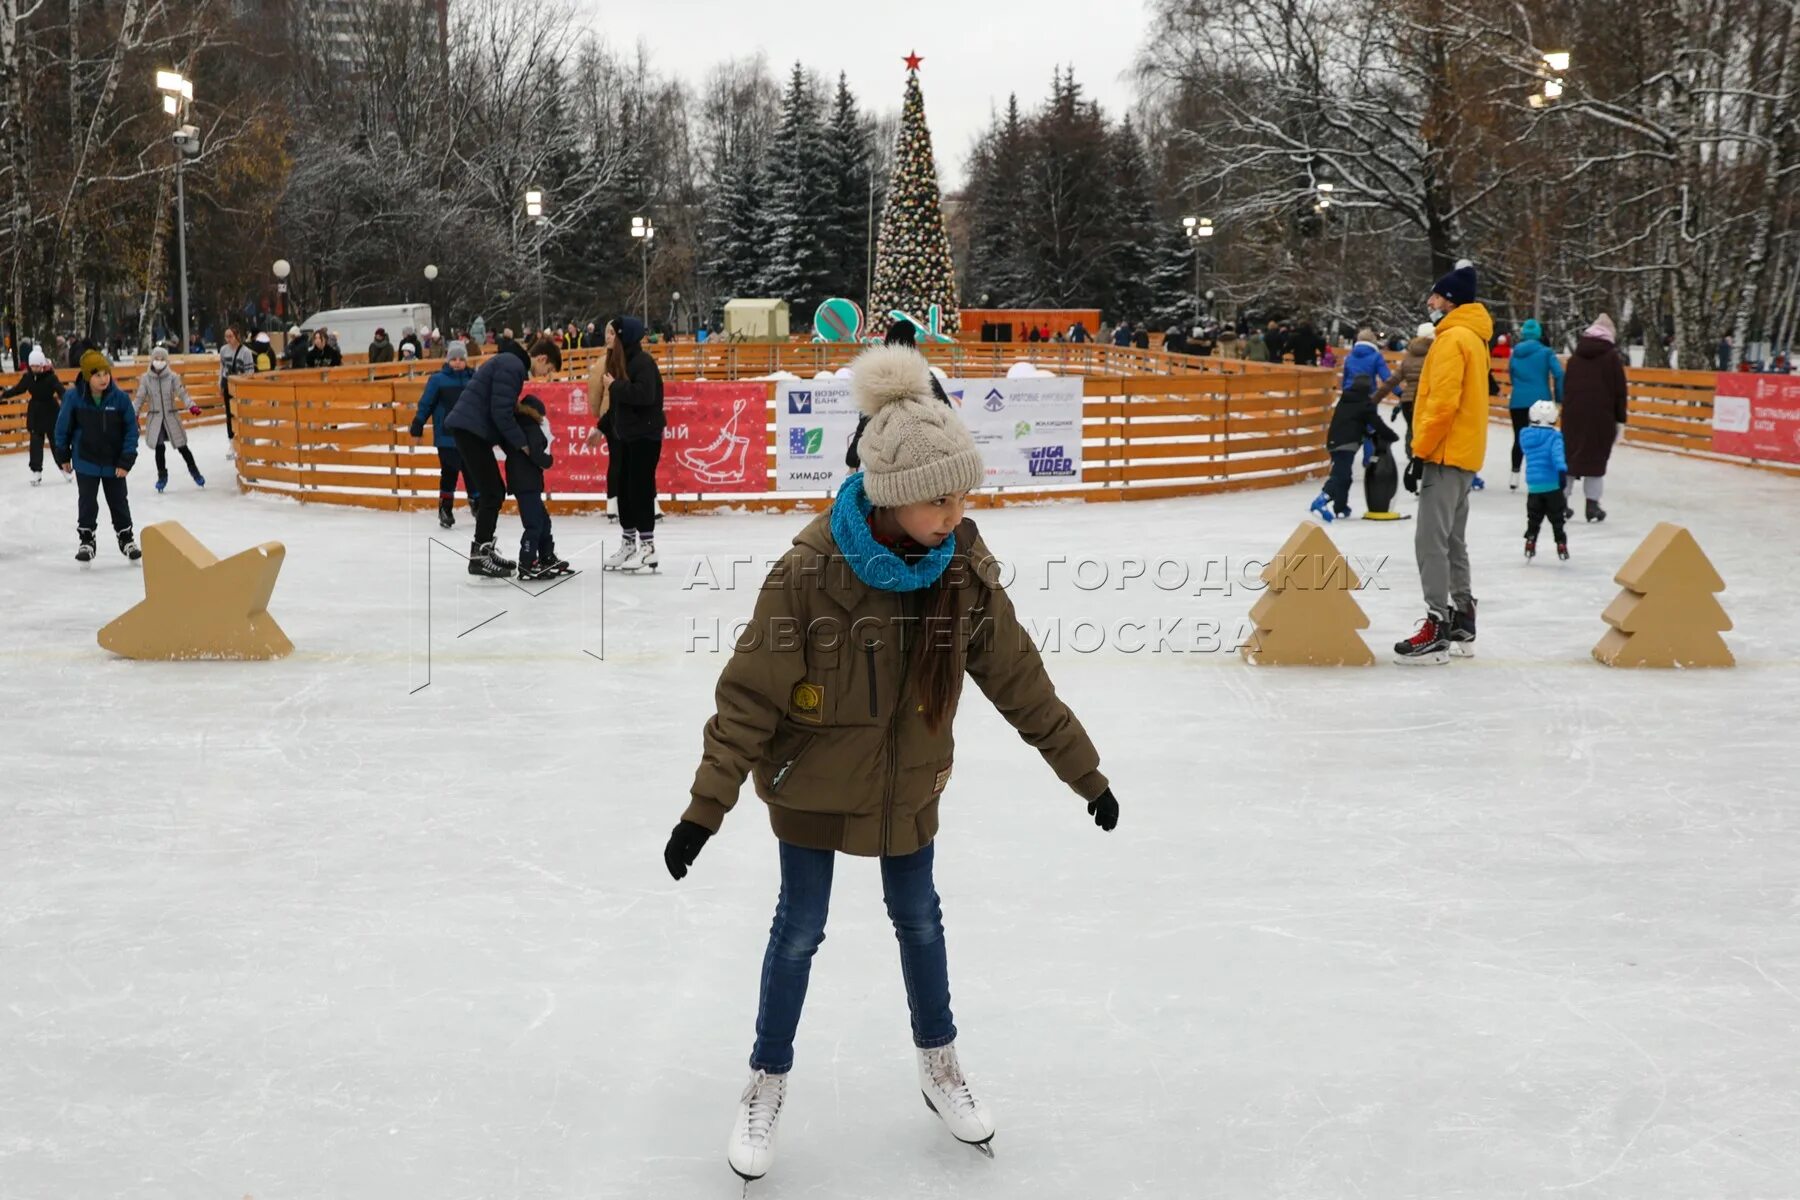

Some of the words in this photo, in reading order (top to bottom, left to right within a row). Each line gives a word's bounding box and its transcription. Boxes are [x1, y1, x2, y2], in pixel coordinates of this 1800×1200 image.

[1031, 446, 1063, 458] GIGA
[1029, 458, 1072, 473] VIDER
[789, 471, 833, 481] ХИМДОР
